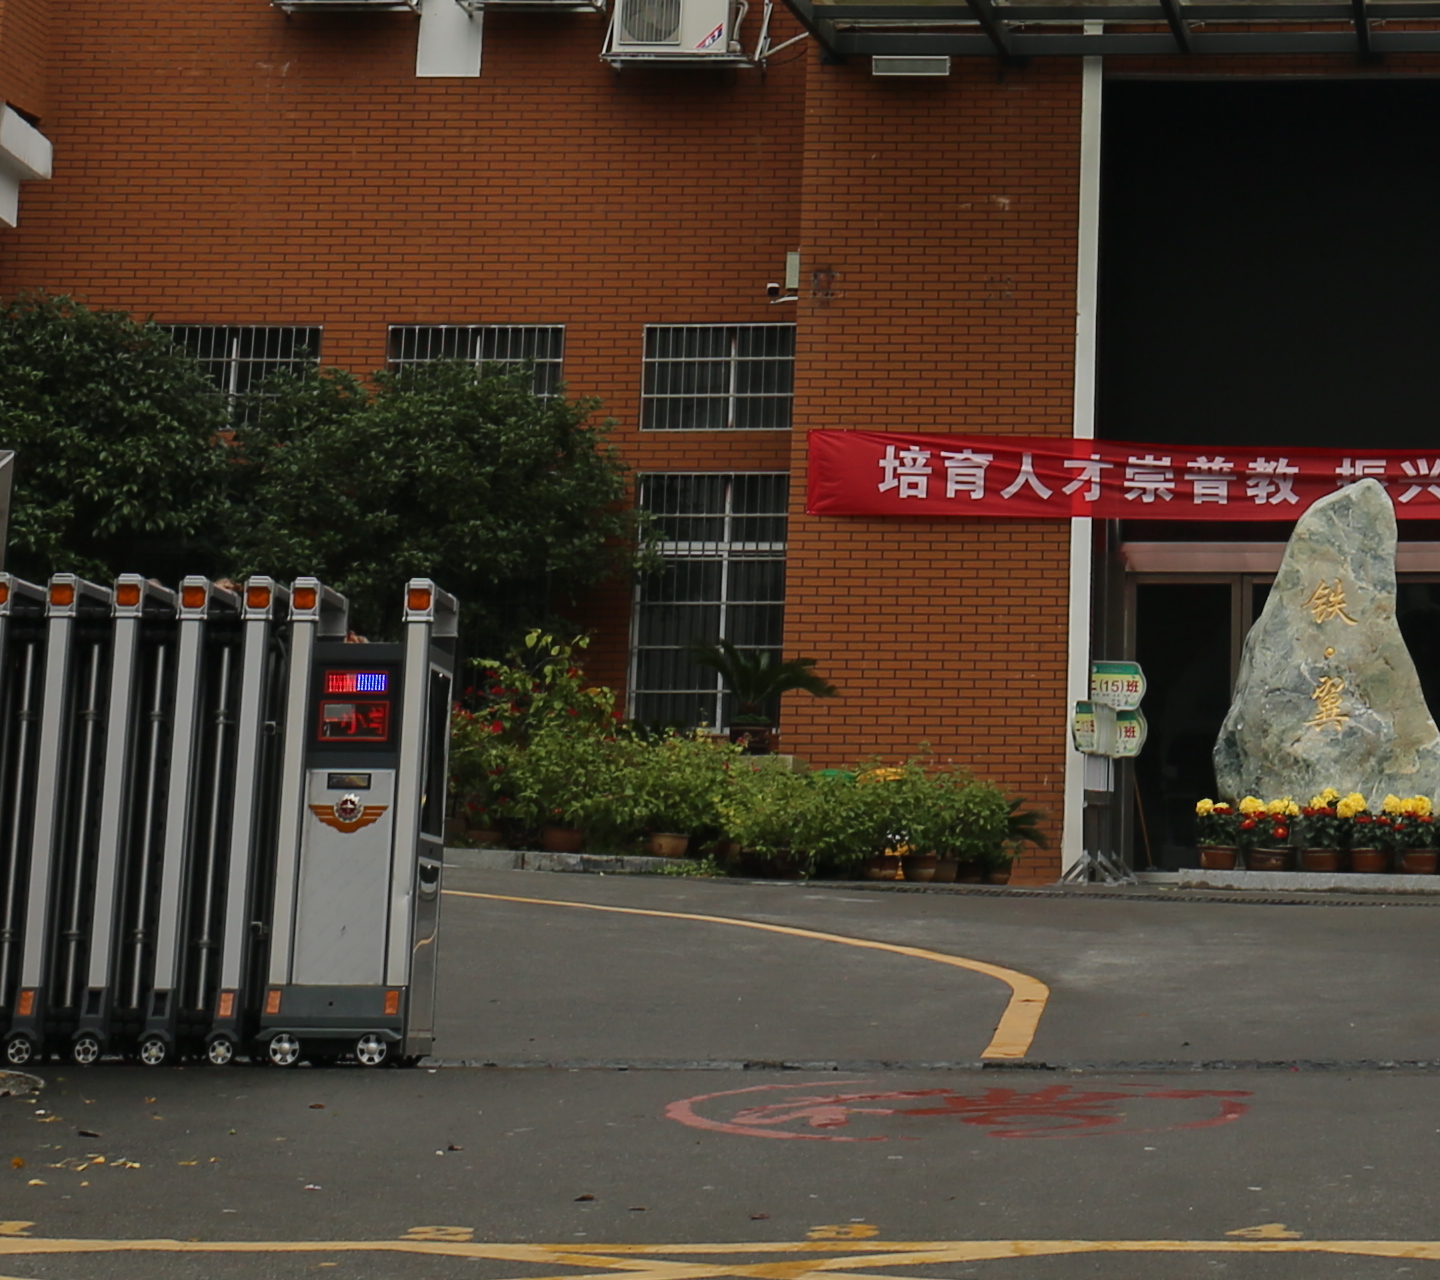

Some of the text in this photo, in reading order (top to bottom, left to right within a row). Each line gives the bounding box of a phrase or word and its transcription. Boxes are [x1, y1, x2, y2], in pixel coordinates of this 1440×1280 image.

[878, 444, 1300, 506] 培育人才崇普教
